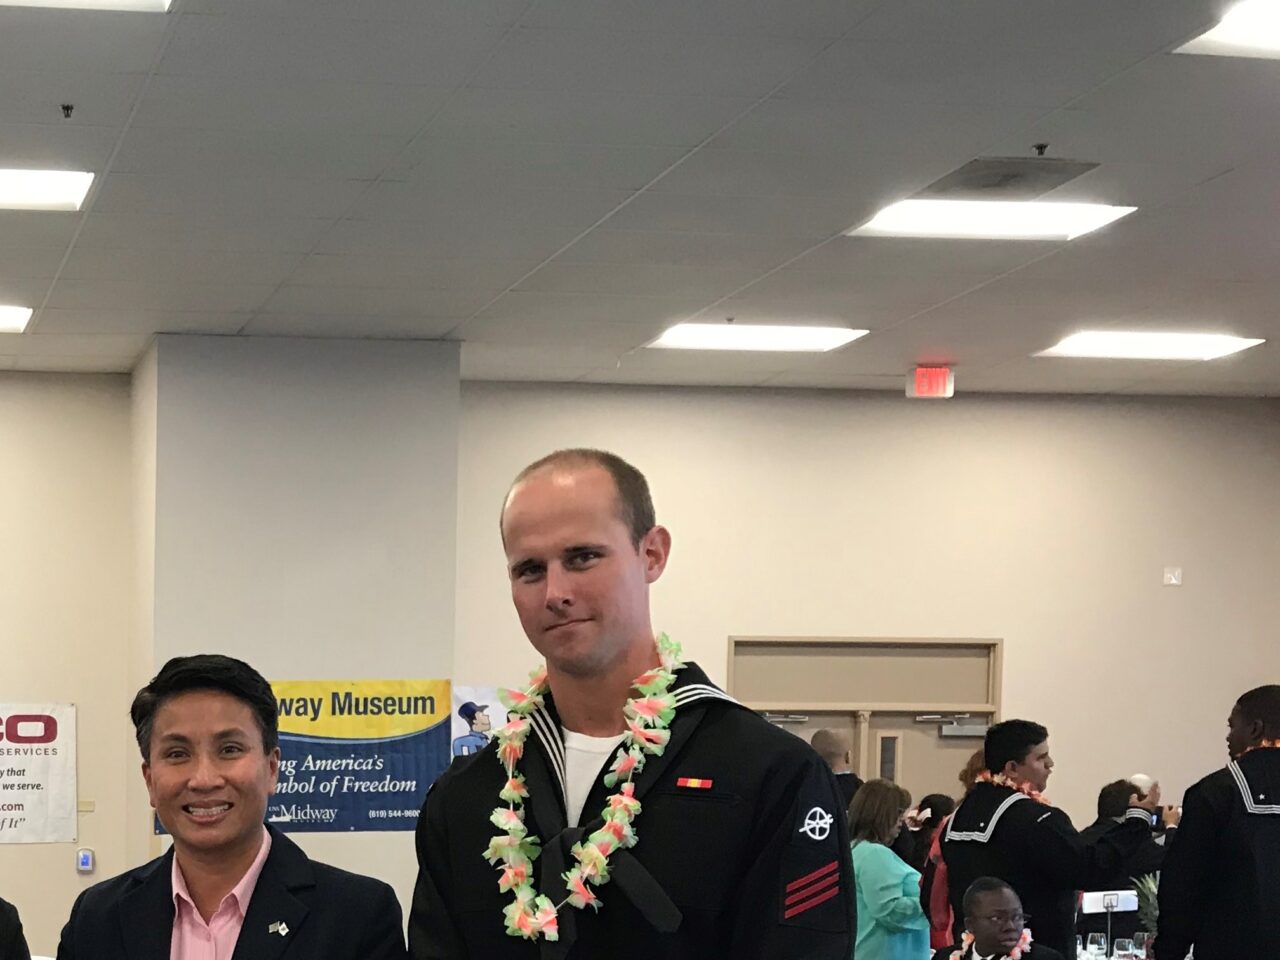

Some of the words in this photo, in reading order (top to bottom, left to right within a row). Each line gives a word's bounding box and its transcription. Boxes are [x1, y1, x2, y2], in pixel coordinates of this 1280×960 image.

[278, 697, 323, 722] way
[331, 692, 435, 716] Museum
[6, 768, 26, 777] that
[277, 759, 298, 776] ng
[300, 754, 384, 771] America's
[320, 775, 340, 797] of
[341, 775, 417, 793] Freedom
[280, 804, 338, 823] Midway
